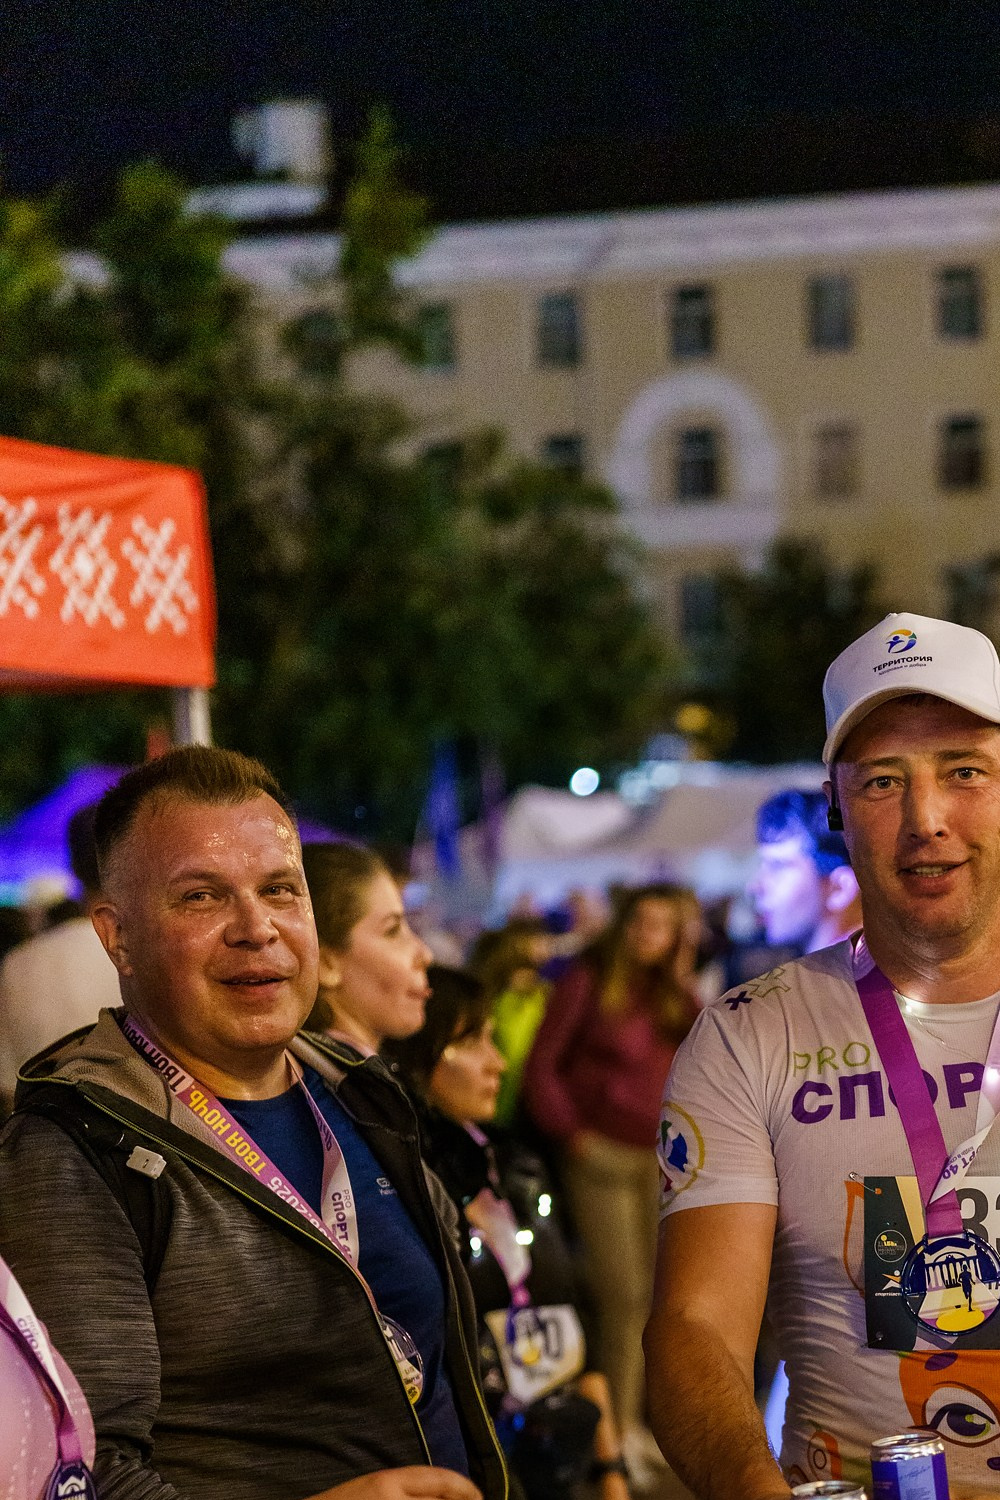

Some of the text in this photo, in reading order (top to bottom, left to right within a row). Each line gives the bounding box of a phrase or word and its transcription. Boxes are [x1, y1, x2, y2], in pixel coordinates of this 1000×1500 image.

[873, 656, 933, 673] ТЕРРИТОРИЯ
[793, 1041, 871, 1078] PRO
[225, 1131, 267, 1176] ТВОЯ
[942, 1164, 959, 1180] 40
[343, 1189, 352, 1209] PRO
[331, 1192, 349, 1241] СПОРТ
